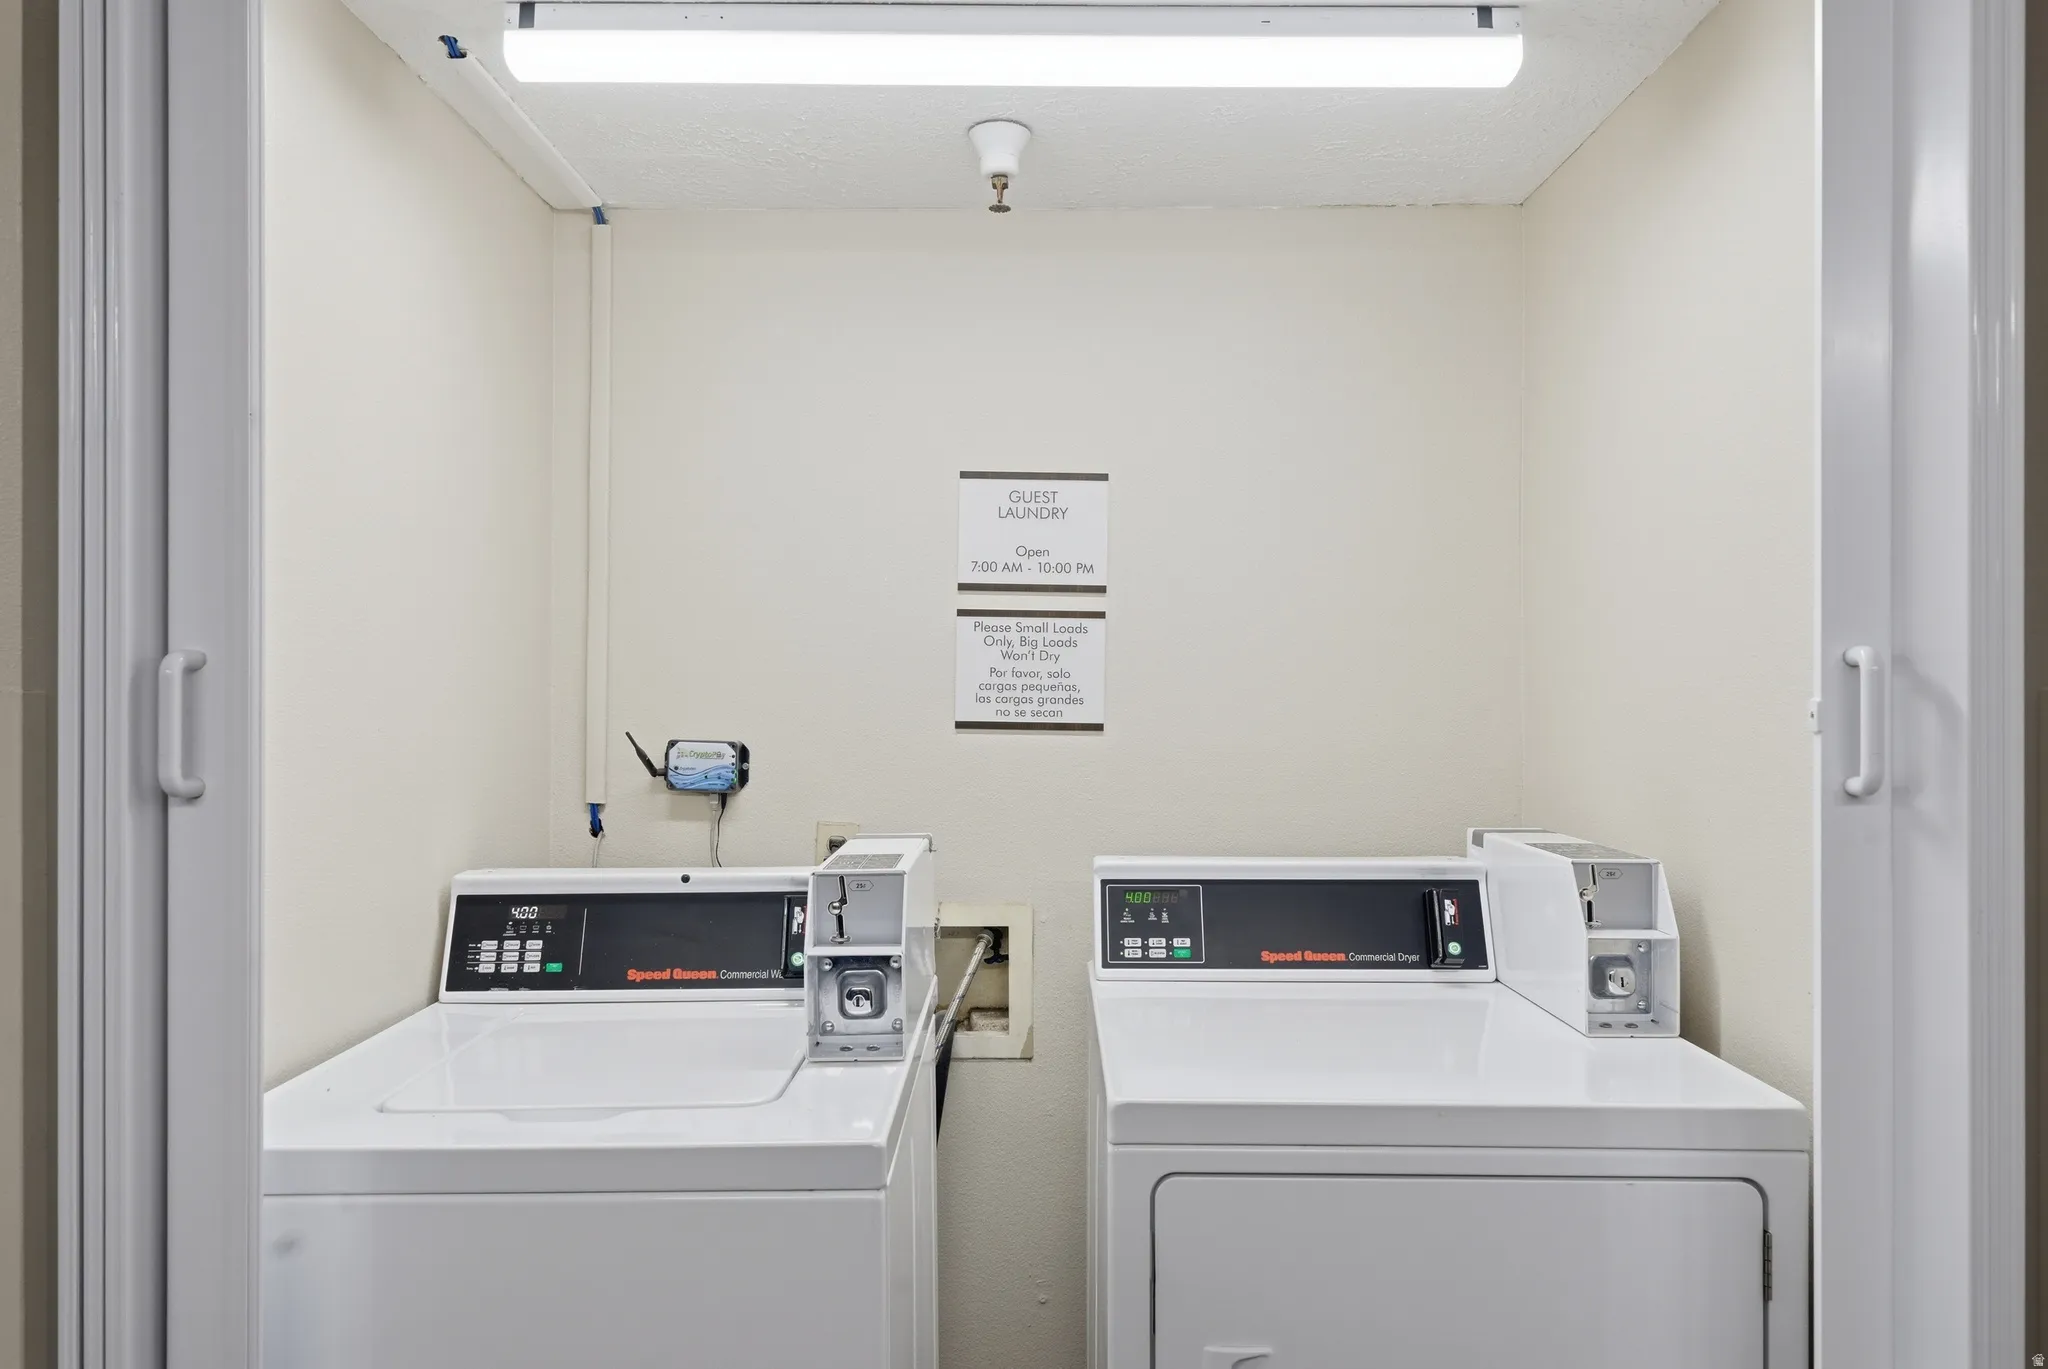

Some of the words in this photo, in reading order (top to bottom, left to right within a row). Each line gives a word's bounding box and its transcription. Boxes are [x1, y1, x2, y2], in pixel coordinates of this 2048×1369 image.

[1008, 490, 1058, 504] GUEST
[998, 506, 1069, 520] LAUNDRY
[1015, 545, 1050, 560] Open
[970, 560, 998, 573] 7:00
[1001, 562, 1023, 573] AM
[1037, 562, 1072, 574] 10:00
[1076, 562, 1095, 574] PM
[973, 621, 1012, 633] Please
[1015, 621, 1049, 634] Small
[1053, 622, 1089, 634] Loads
[983, 635, 1015, 649] Only,
[1019, 636, 1038, 650] Big
[1042, 636, 1078, 648] Loads
[1039, 650, 1061, 664] Dry
[989, 667, 1008, 678] Por
[1011, 667, 1043, 680] favor,
[1047, 668, 1071, 679] solo
[978, 682, 1017, 693] cargas
[1021, 682, 1081, 696] pequeñas,
[975, 693, 992, 704] las
[995, 695, 1034, 706] cargas
[1037, 694, 1085, 707] grandes
[995, 709, 1010, 717] no
[1014, 709, 1027, 717] se
[1030, 709, 1063, 718] secan
[1125, 891, 1152, 904] 4.00
[511, 906, 539, 919] 4.00
[1260, 950, 1302, 964] Speed
[1303, 950, 1346, 962] Queen
[1348, 952, 1397, 963] Commercial
[1398, 952, 1420, 964] Dryer
[626, 968, 672, 983] Speed
[672, 967, 717, 980] Queen
[719, 969, 769, 980] Commercial
